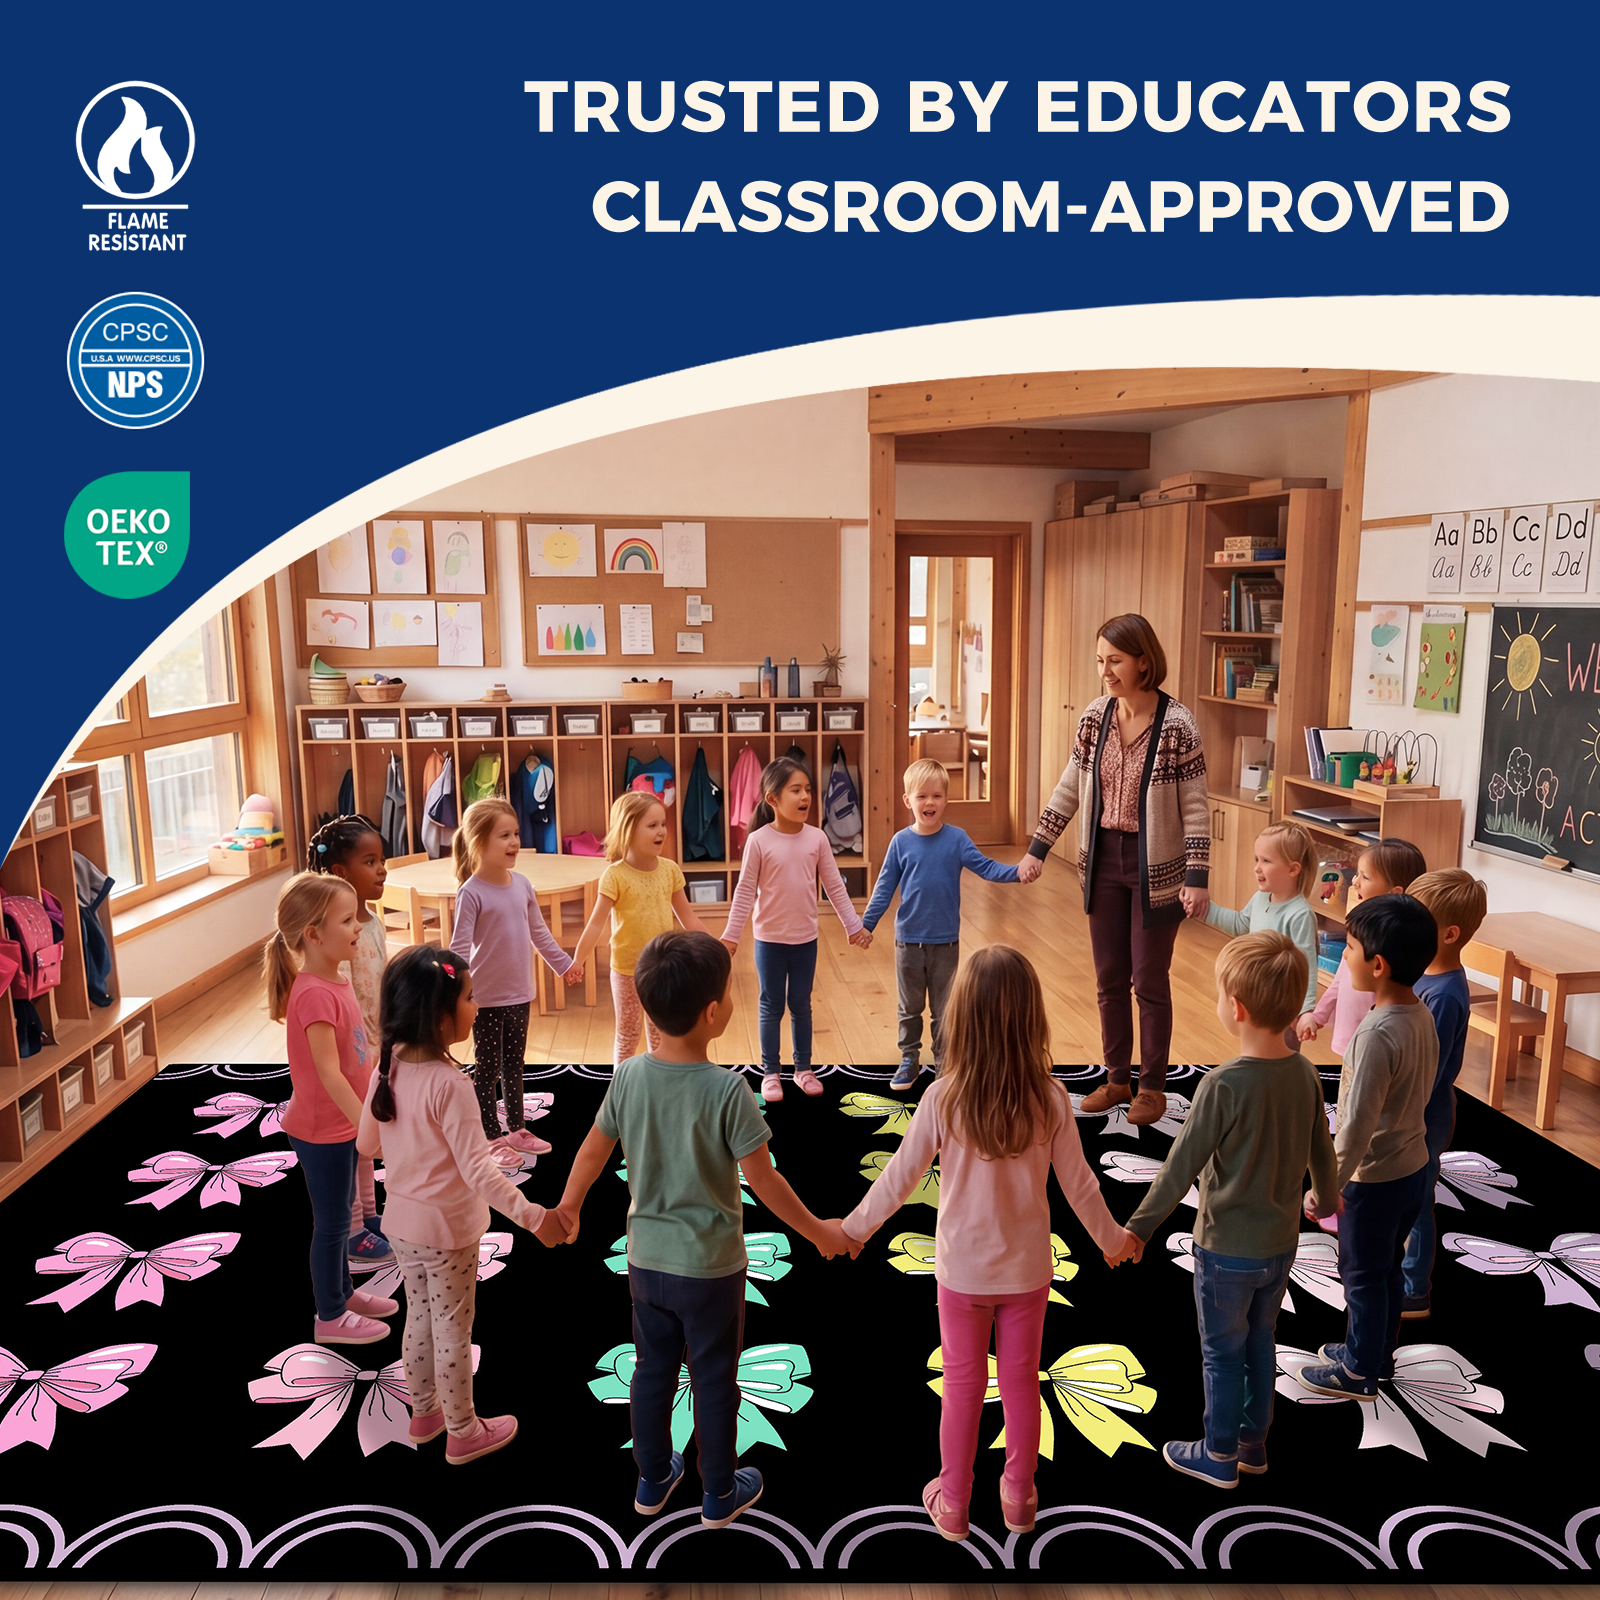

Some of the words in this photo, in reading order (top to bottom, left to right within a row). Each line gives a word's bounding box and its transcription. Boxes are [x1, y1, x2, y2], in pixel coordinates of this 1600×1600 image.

[1434, 521, 1459, 546] Aa
[1472, 517, 1498, 544] Bb
[1513, 515, 1540, 542] Cc
[1555, 508, 1589, 540] Dd
[1432, 556, 1455, 579] Aa
[1469, 554, 1493, 579] Bb
[1512, 553, 1532, 578] Cc
[1551, 551, 1584, 576] Dd
[1559, 805, 1600, 845] AC
